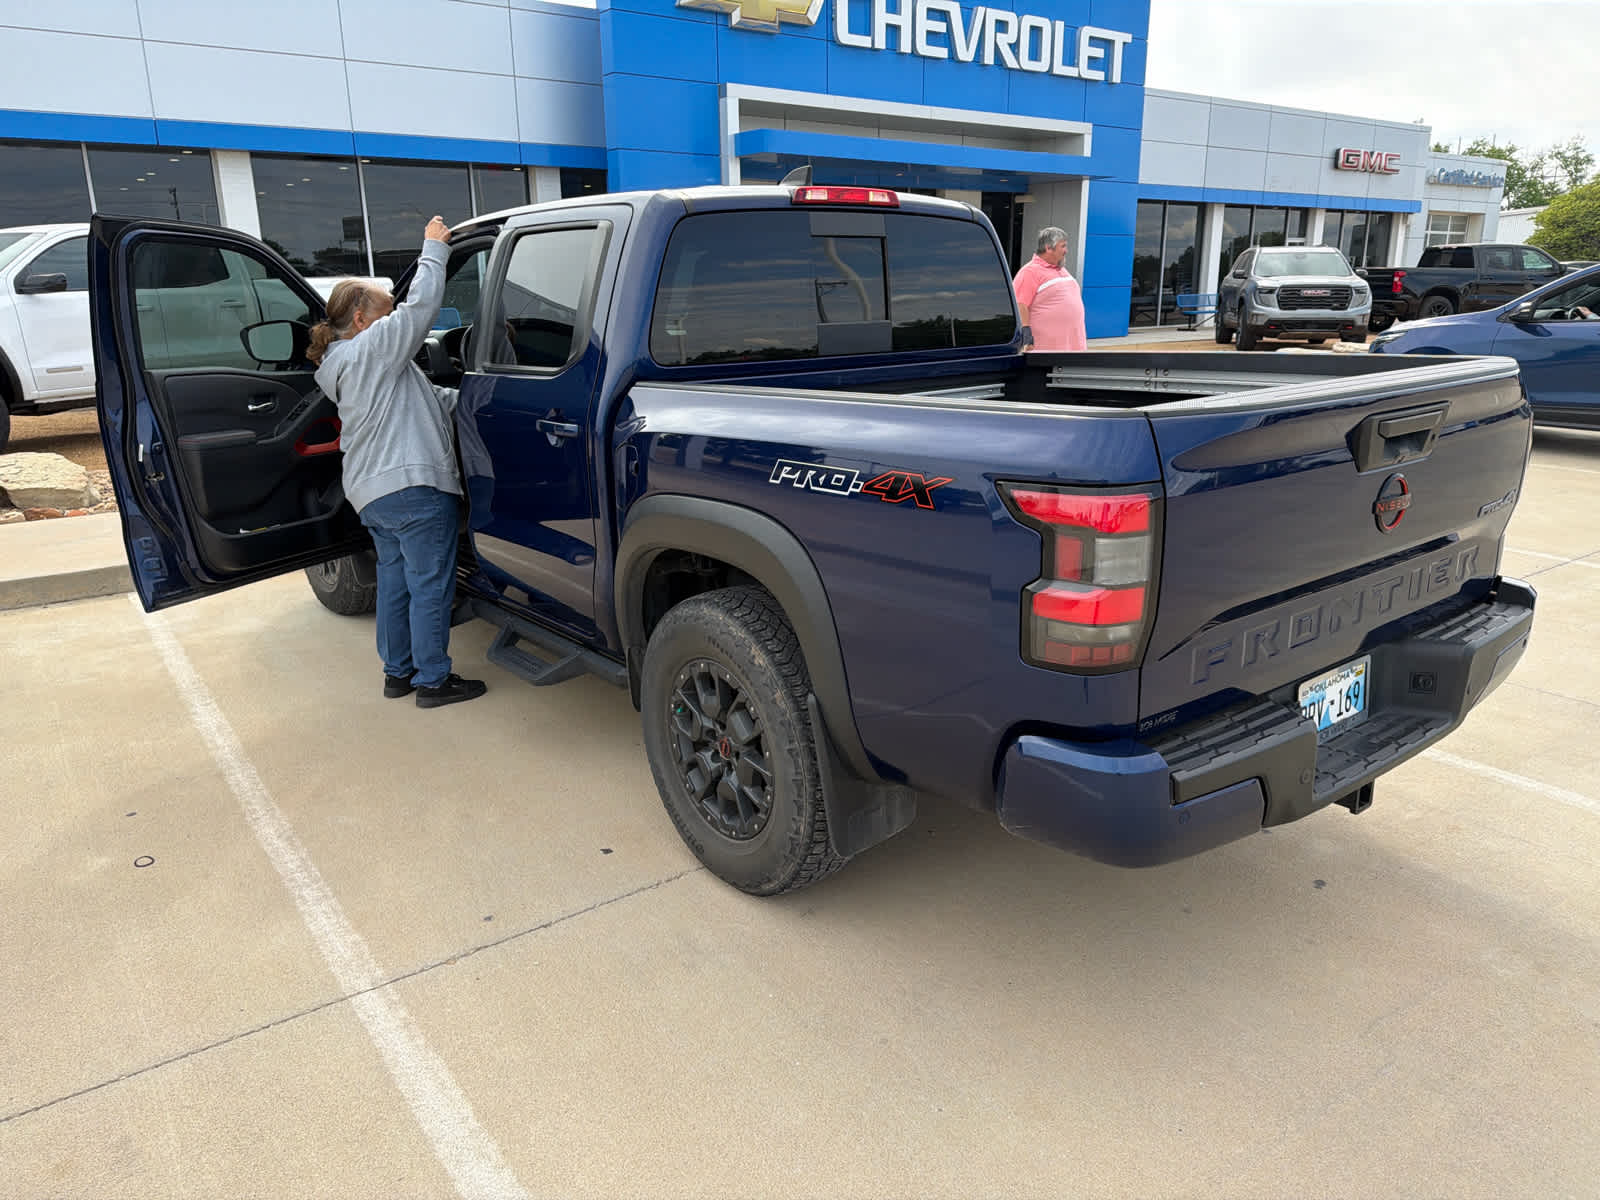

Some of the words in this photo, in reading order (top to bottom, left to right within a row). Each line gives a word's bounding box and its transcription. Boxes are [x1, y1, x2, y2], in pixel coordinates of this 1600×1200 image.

[835, 0, 1132, 84] CHEVROLET
[1339, 148, 1400, 174] GMC
[1190, 544, 1480, 685] FRONTIER
